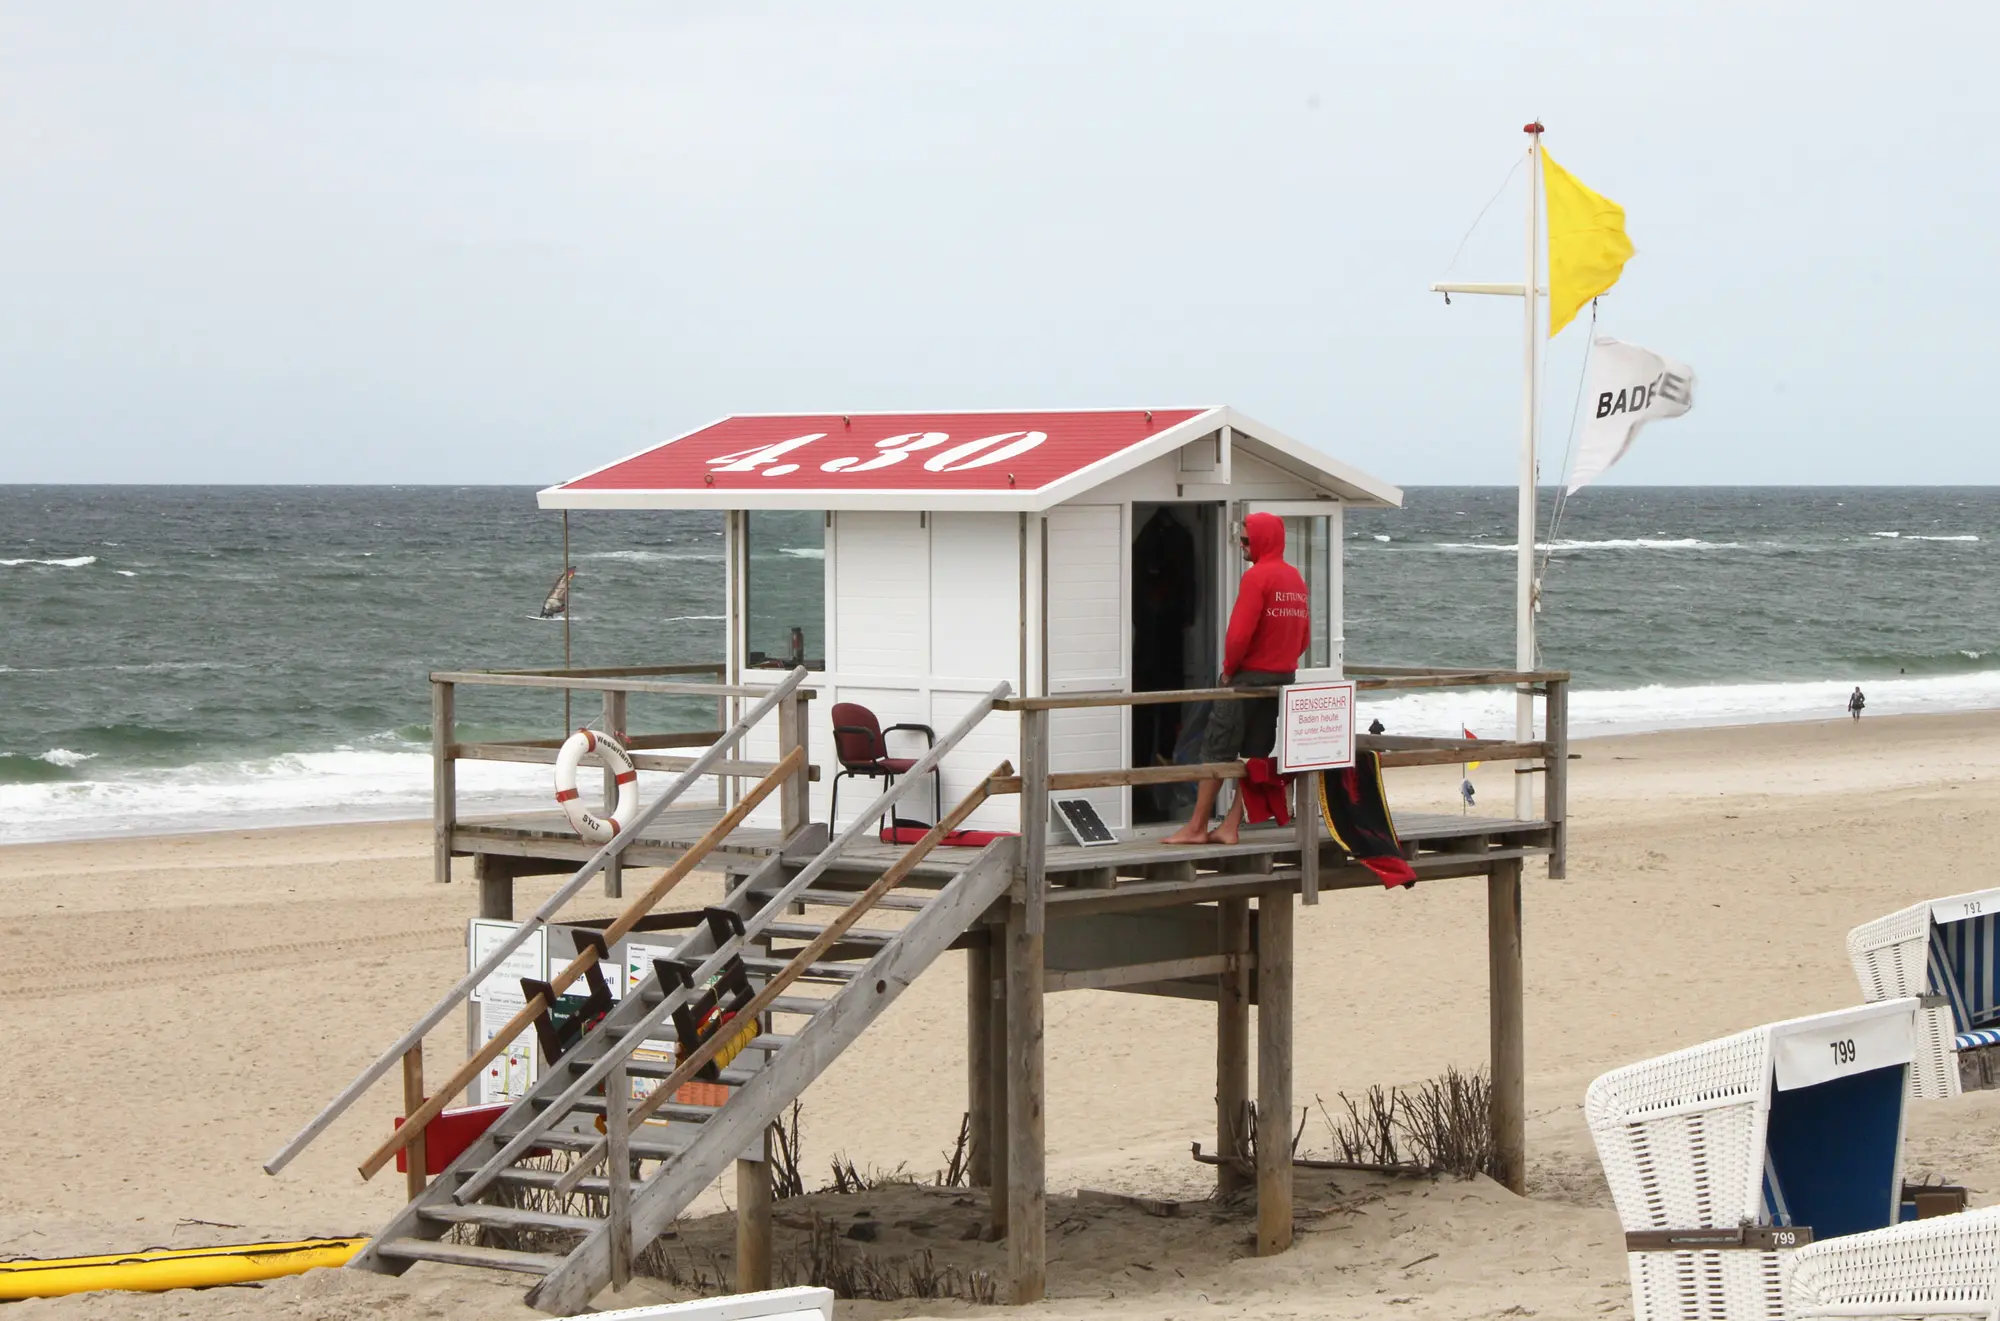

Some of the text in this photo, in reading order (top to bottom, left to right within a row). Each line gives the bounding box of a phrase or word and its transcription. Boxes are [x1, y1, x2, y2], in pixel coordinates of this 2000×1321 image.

[706, 431, 1047, 476] 4.30
[1291, 696, 1346, 711] LEBENSGEFAHR
[1298, 713, 1339, 724] Baden heute
[597, 735, 633, 769] Westerland
[582, 814, 600, 831] SYLT
[1964, 901, 1982, 915] 792
[1830, 1039, 1855, 1065] 799
[1772, 1232, 1795, 1244] 799
